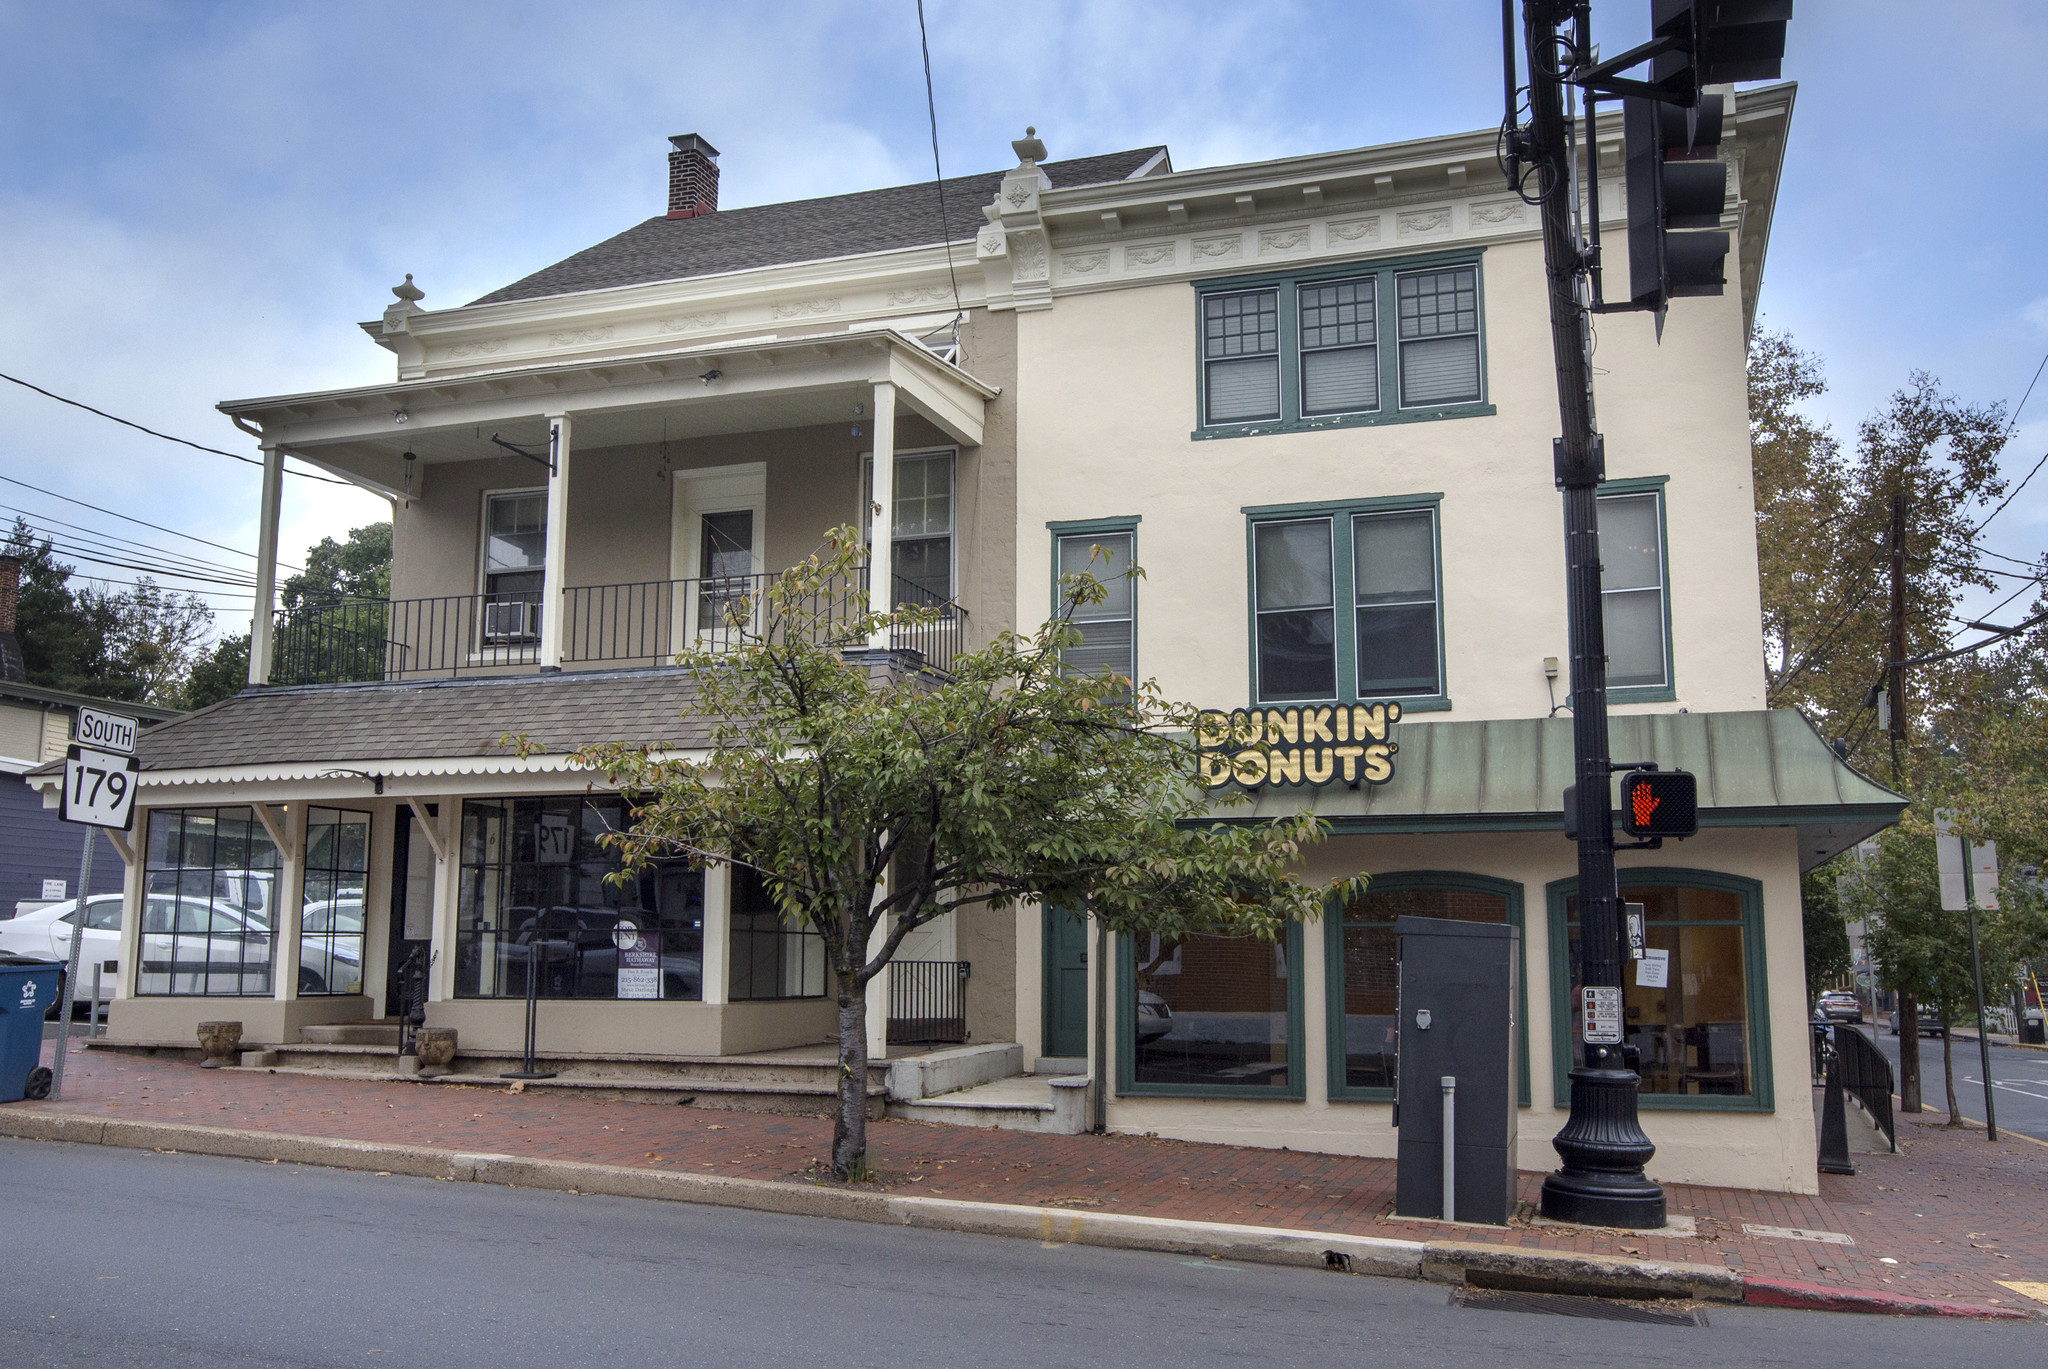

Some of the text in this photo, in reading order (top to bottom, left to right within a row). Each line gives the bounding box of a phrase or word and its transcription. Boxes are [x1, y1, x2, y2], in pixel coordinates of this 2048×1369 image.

[82, 714, 132, 746] SOUTH
[1199, 703, 1399, 748] DUNKIN'
[74, 765, 127, 811] 179
